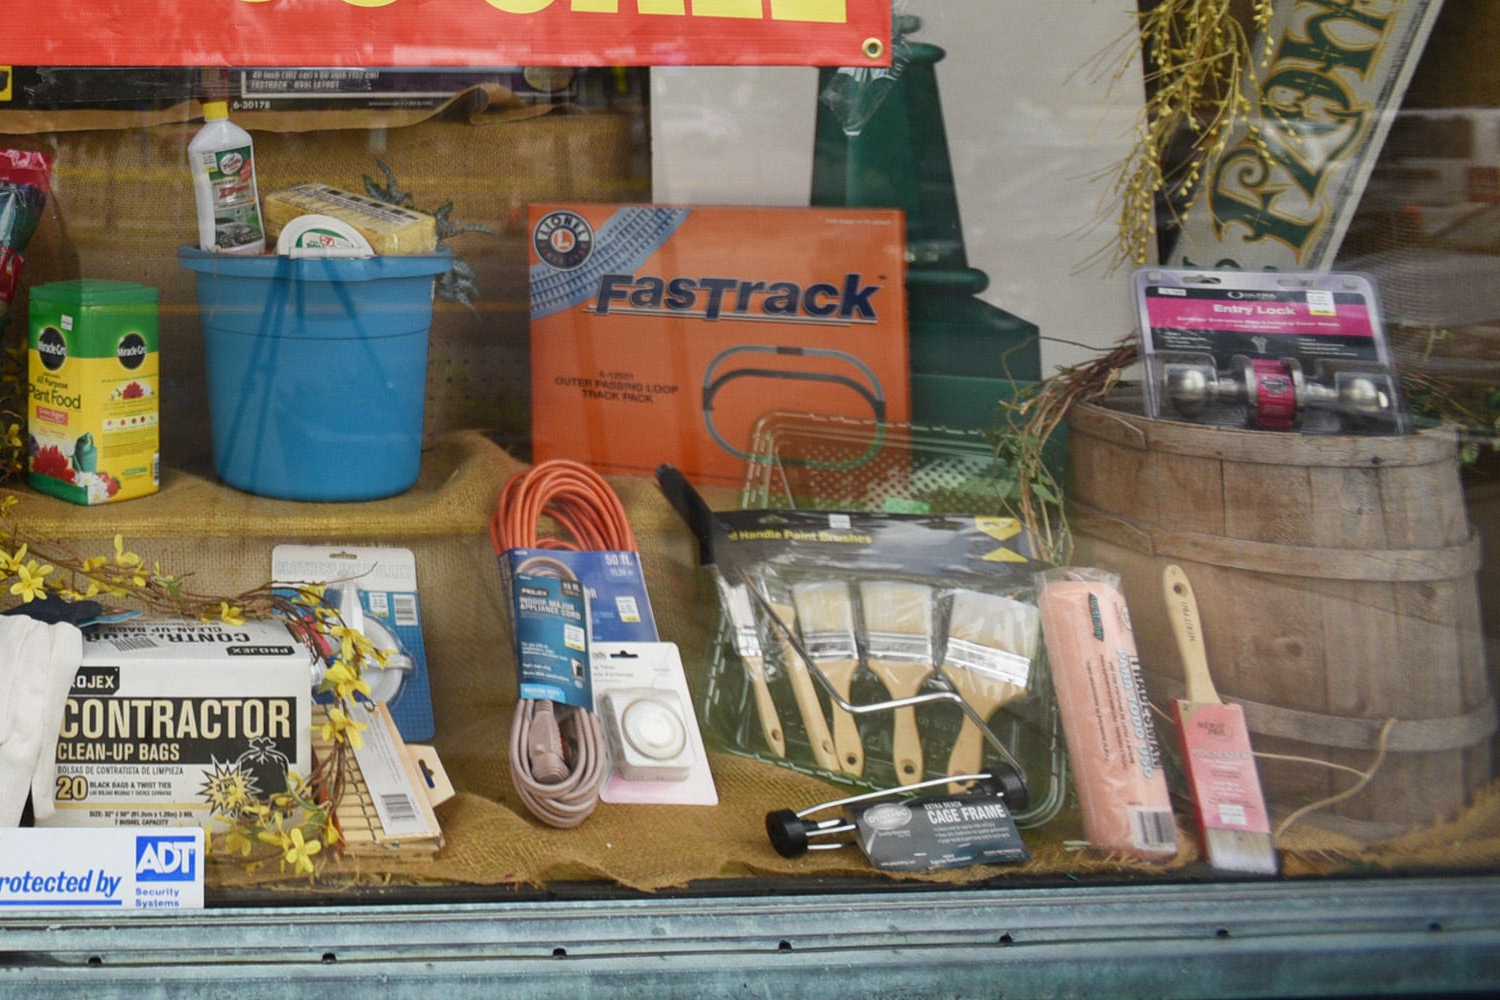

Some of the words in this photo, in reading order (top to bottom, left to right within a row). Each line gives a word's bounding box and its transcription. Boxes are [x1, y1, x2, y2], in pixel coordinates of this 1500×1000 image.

[233, 100, 271, 110] 6-30178
[540, 215, 588, 236] LIONEL
[1214, 304, 1252, 317] Entry
[1257, 305, 1297, 316] Lock
[45, 378, 69, 390] Purpose
[28, 382, 50, 405] Plant
[52, 391, 81, 410] Food
[582, 388, 620, 401] TRACK
[623, 392, 653, 403] PACK
[740, 528, 782, 541] Handle
[784, 530, 817, 542] Paint
[819, 531, 872, 545] Brushes
[605, 554, 618, 566] 50
[71, 675, 115, 690] OJEX
[60, 699, 291, 740] CONTRACTOR
[58, 743, 133, 762] CLEAN-UP
[139, 742, 180, 761] BAGS
[57, 765, 84, 775] BOLSAS
[85, 766, 94, 775] DE
[96, 766, 140, 776] CONTRATISTA
[142, 766, 151, 775] DE
[152, 766, 184, 776] LIMPIEZA
[56, 776, 88, 800] 20
[928, 809, 961, 824] CAGE
[962, 804, 1007, 821] FRAME
[136, 842, 195, 875] ADT
[96, 871, 121, 898] by
[135, 888, 179, 898] Security
[135, 898, 179, 908] Systems
